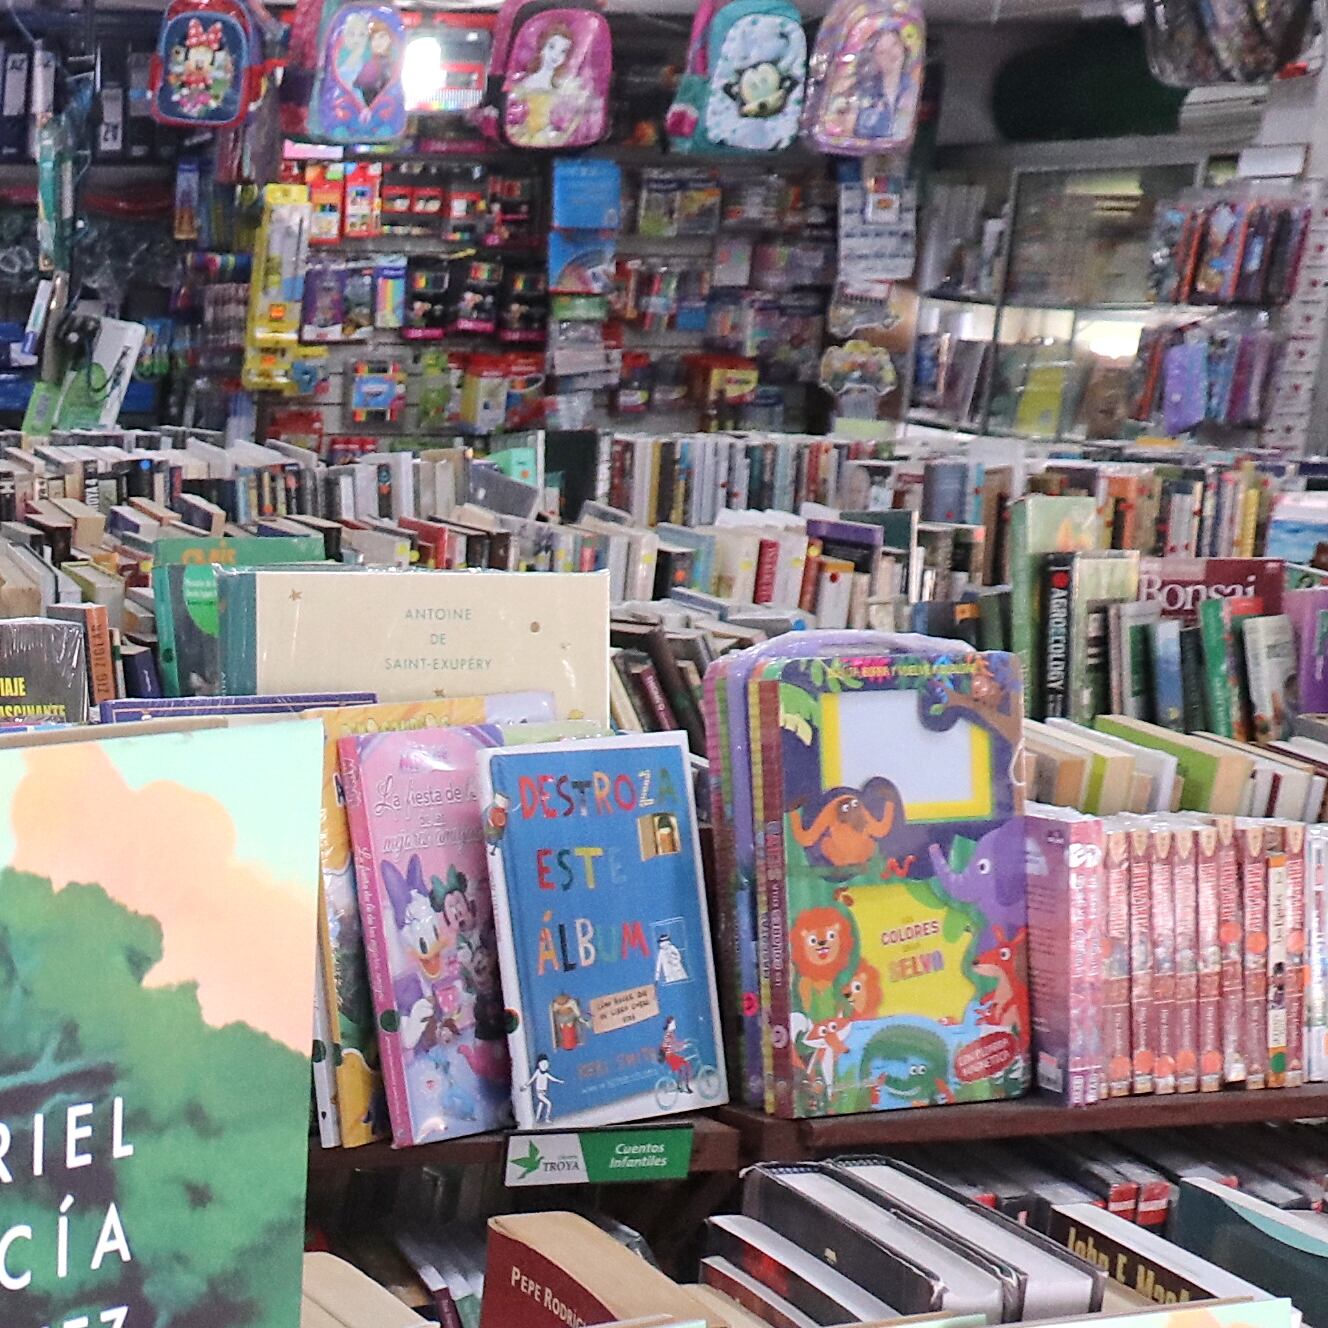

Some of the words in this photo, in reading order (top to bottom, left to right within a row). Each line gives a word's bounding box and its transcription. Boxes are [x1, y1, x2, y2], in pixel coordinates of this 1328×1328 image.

[1140, 575, 1257, 611] Bonsai
[405, 607, 472, 621] ANTOINE
[430, 633, 447, 646] DE
[1047, 588, 1067, 692] AGROECOLOGY
[518, 768, 678, 820] DESTROZA
[536, 846, 627, 892] ESTE
[537, 911, 651, 976] ÁLBUM
[881, 921, 940, 947] COLORES
[609, 1156, 667, 1168] Infantiles
[615, 1143, 665, 1155] Cuentos
[543, 1161, 580, 1172] TROYA
[510, 1265, 542, 1301] PEPE
[543, 1286, 587, 1328] RODRÍG
